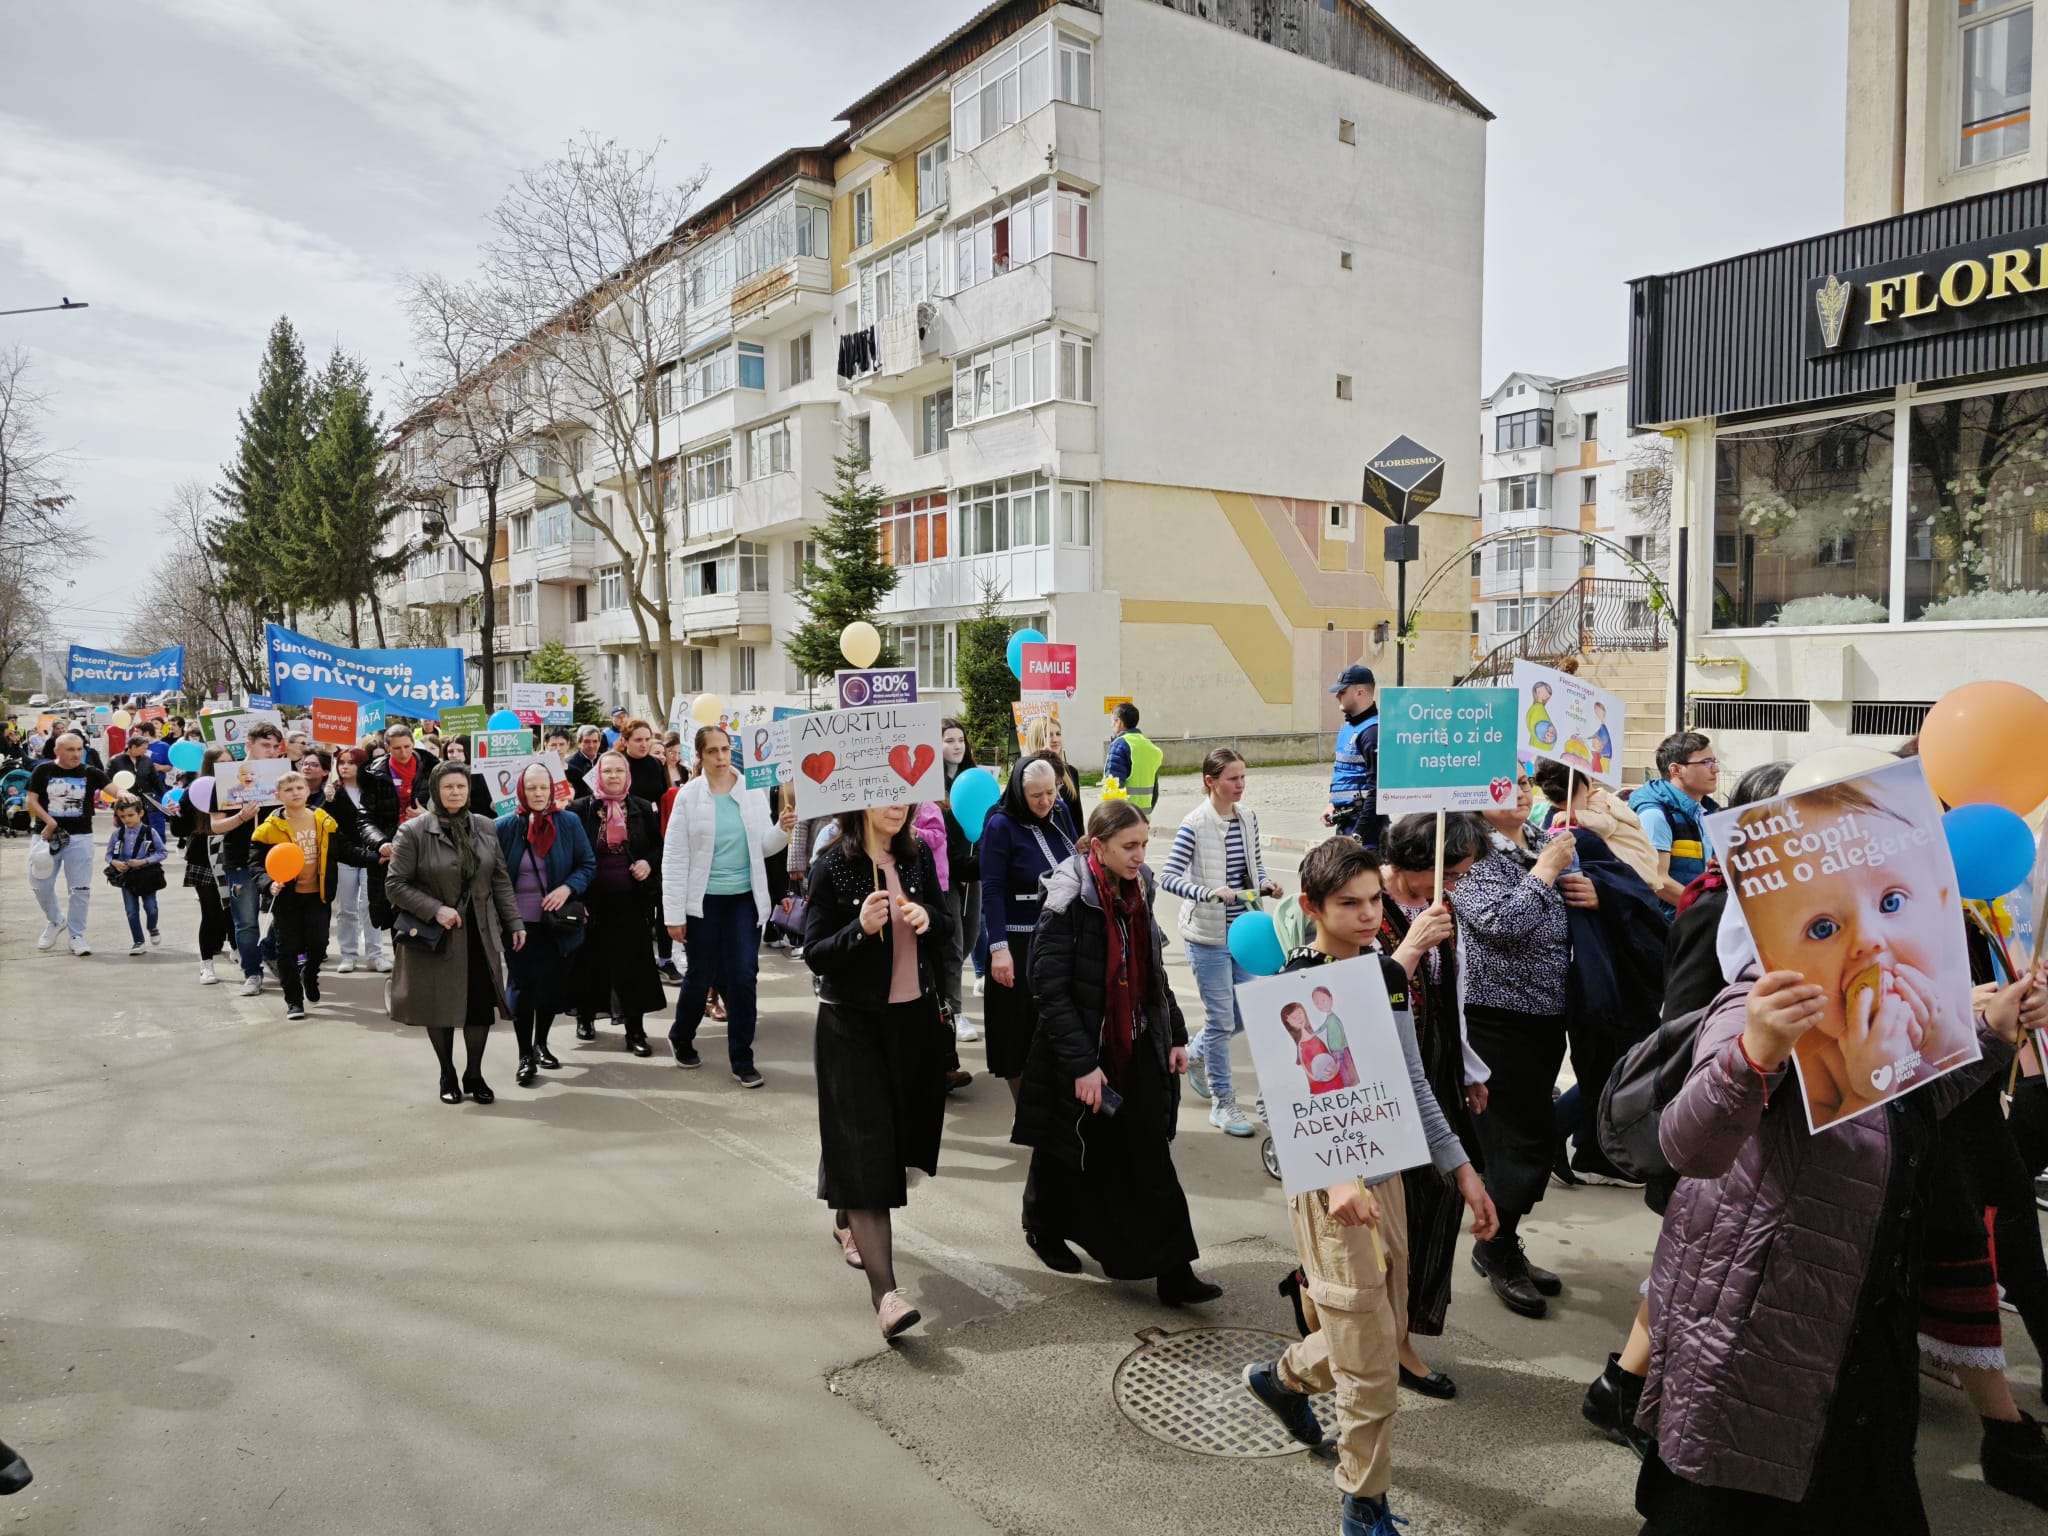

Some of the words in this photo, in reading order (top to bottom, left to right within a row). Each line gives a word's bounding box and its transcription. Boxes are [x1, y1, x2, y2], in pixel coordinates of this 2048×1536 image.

[1374, 456, 1437, 468] FLORISSIMO
[72, 654, 107, 665] Suntem
[272, 639, 332, 662] Suntem
[71, 667, 134, 682] pentru
[1029, 660, 1071, 675] FAMILIE
[274, 661, 375, 693] pentru
[384, 675, 460, 708] viață.
[872, 674, 909, 692] 80%
[1408, 703, 1453, 721] Orice
[1457, 703, 1494, 724] copil
[490, 734, 519, 747] 80%
[893, 732, 906, 742] se
[1396, 728, 1449, 745] merită
[1453, 734, 1463, 743] o
[1467, 727, 1479, 743] zi
[1483, 726, 1503, 743] de
[1420, 750, 1481, 773] naștere!
[841, 792, 856, 802] se
[1726, 803, 1805, 848] Sunt
[1730, 843, 1780, 873] un
[1783, 812, 1870, 858] copil,
[1740, 869, 1789, 898] nu
[1793, 862, 1814, 882] o
[1820, 816, 1936, 876] alegere!
[1332, 1129, 1367, 1145] aleg
